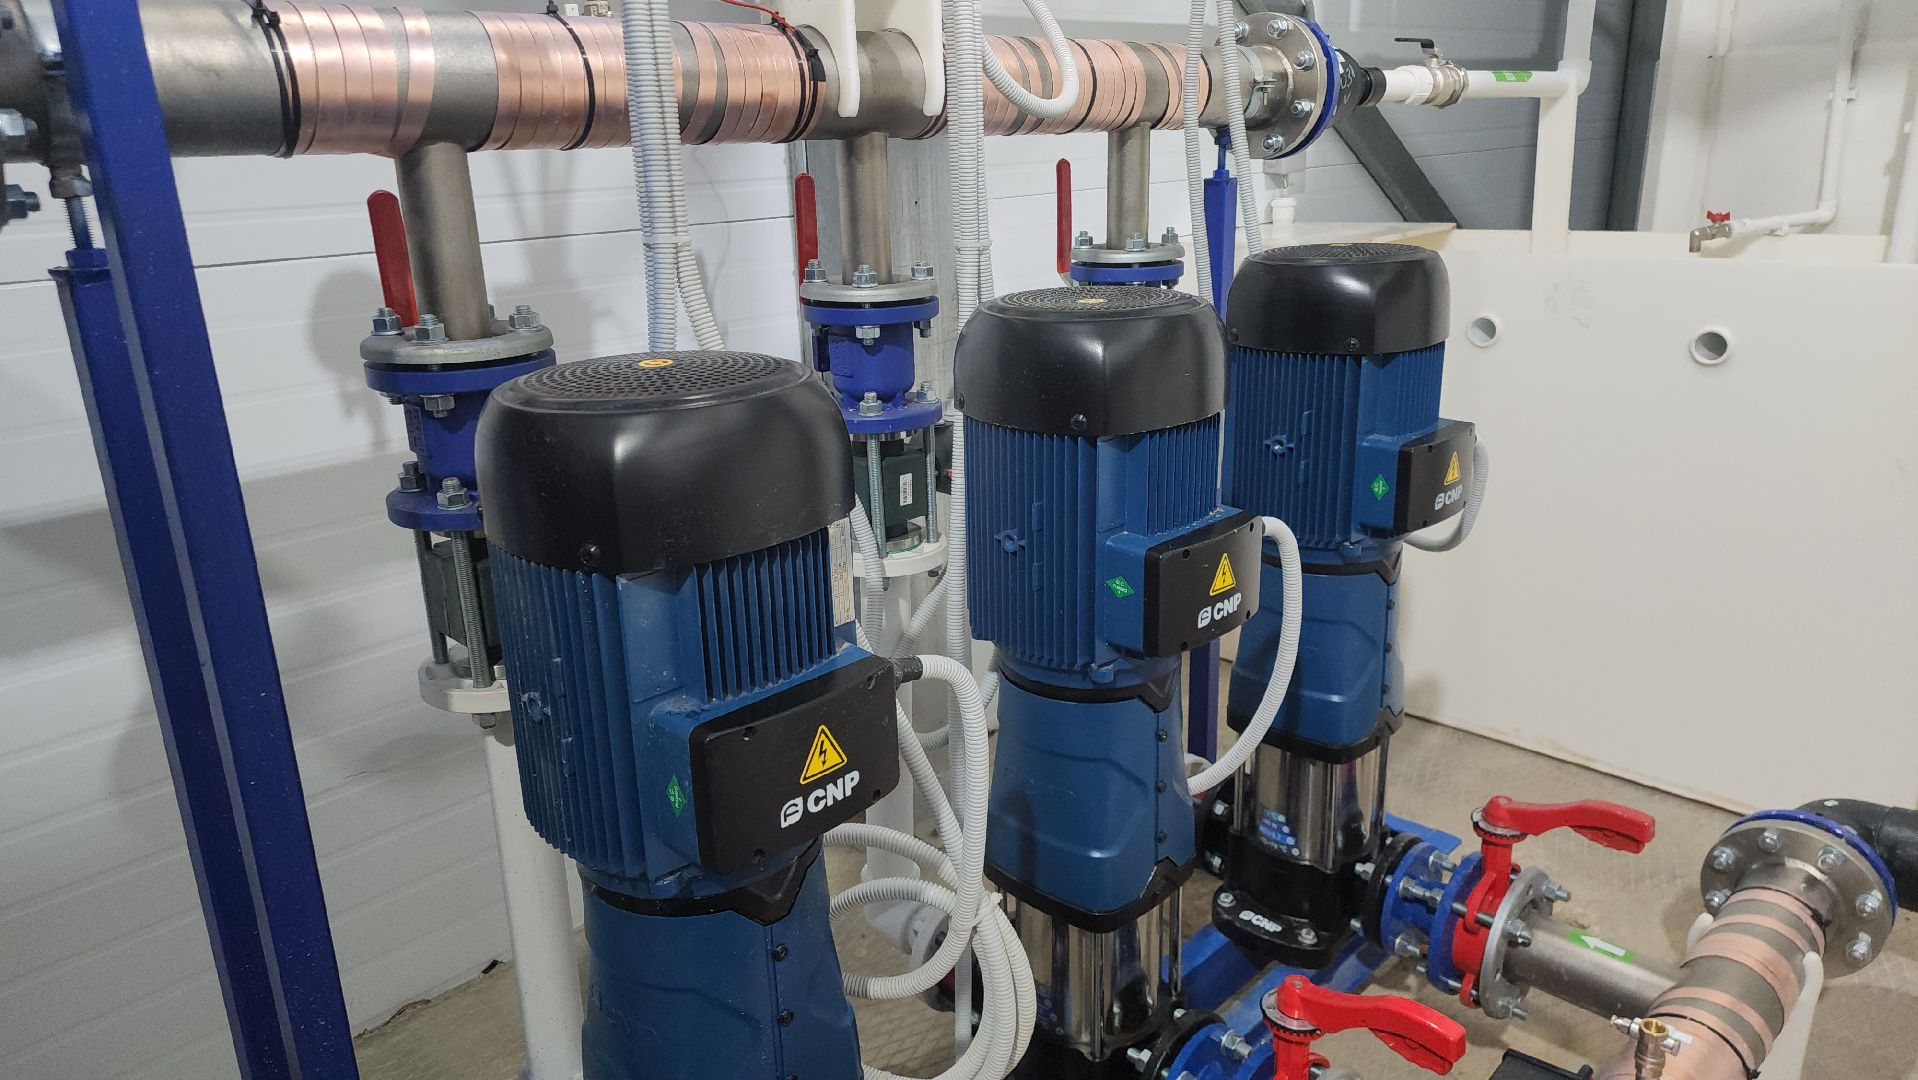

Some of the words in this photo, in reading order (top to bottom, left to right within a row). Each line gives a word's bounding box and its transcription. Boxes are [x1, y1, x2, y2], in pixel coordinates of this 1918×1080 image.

[1445, 484, 1462, 504] CNP
[1213, 592, 1242, 620] CNP
[807, 770, 860, 813] CNP
[1251, 914, 1282, 932] CNP
